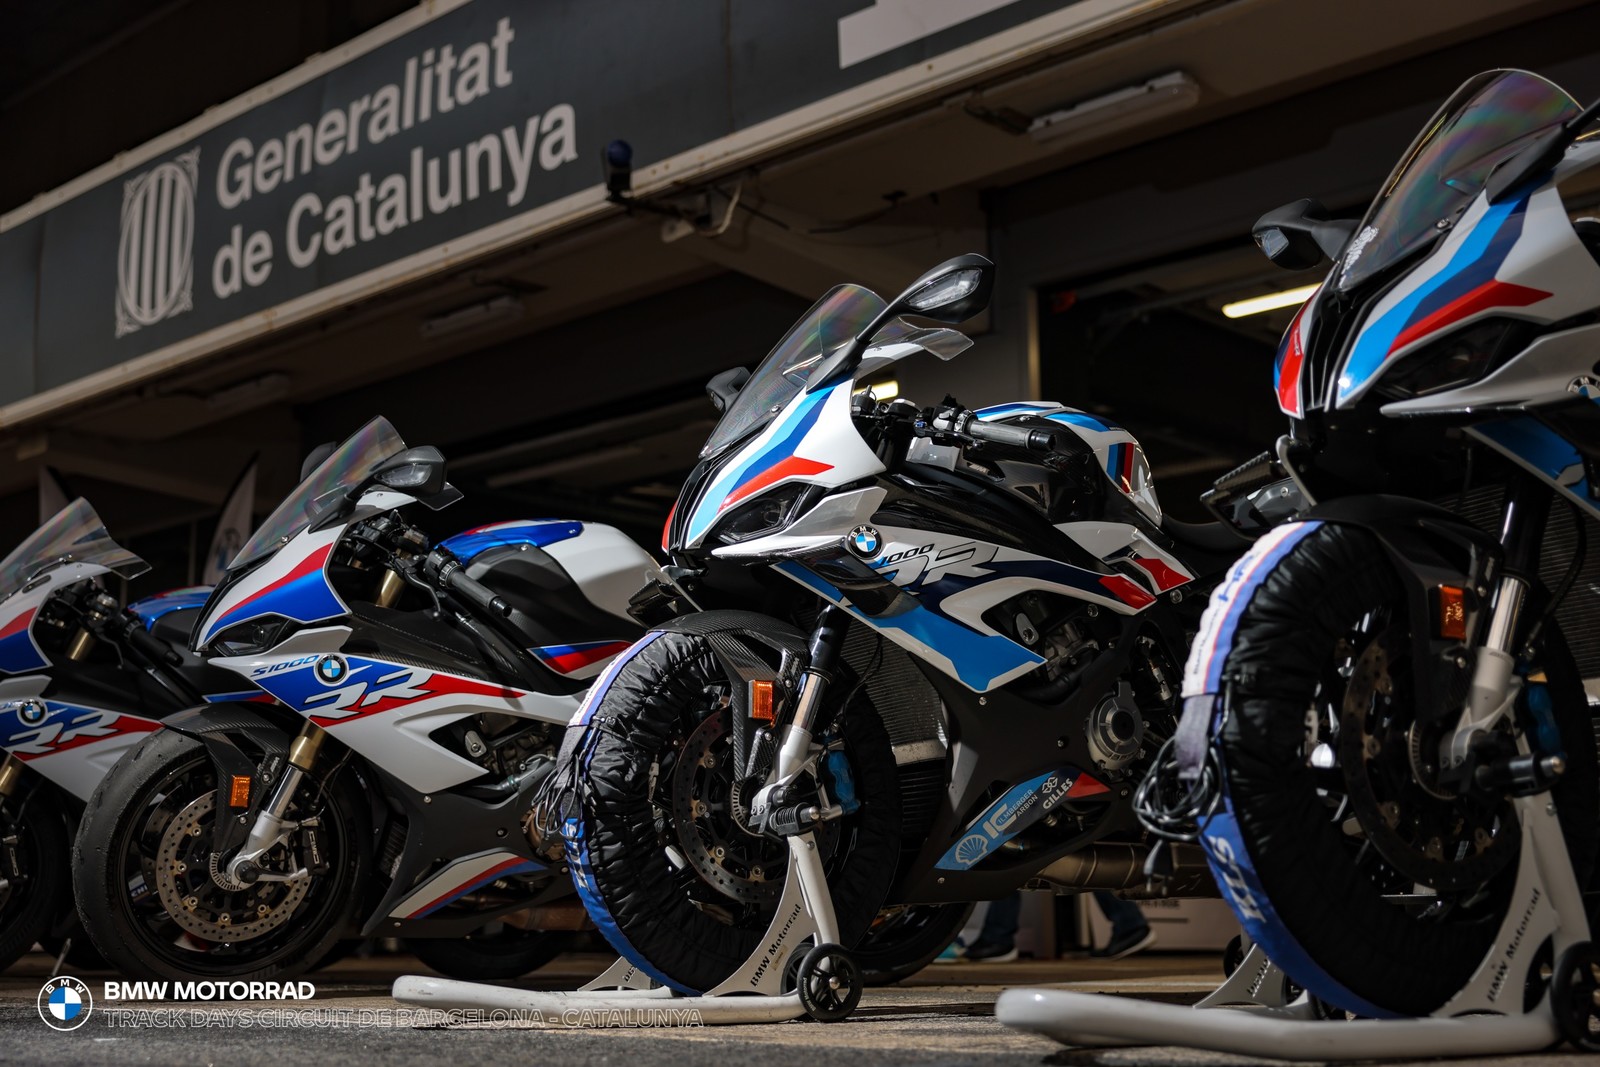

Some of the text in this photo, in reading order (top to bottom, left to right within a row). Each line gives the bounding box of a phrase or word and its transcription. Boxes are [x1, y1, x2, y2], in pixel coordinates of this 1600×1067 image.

[215, 17, 516, 210] Generalitat
[211, 103, 578, 300] de Catalunya
[851, 526, 878, 538] BMW
[880, 543, 936, 566] 1000
[250, 654, 320, 678] S1000
[1042, 778, 1073, 810] GILLES
[1207, 835, 1267, 924] KLS
[750, 903, 802, 987] BMW Motorrad
[1505, 887, 1541, 960] Motorrad
